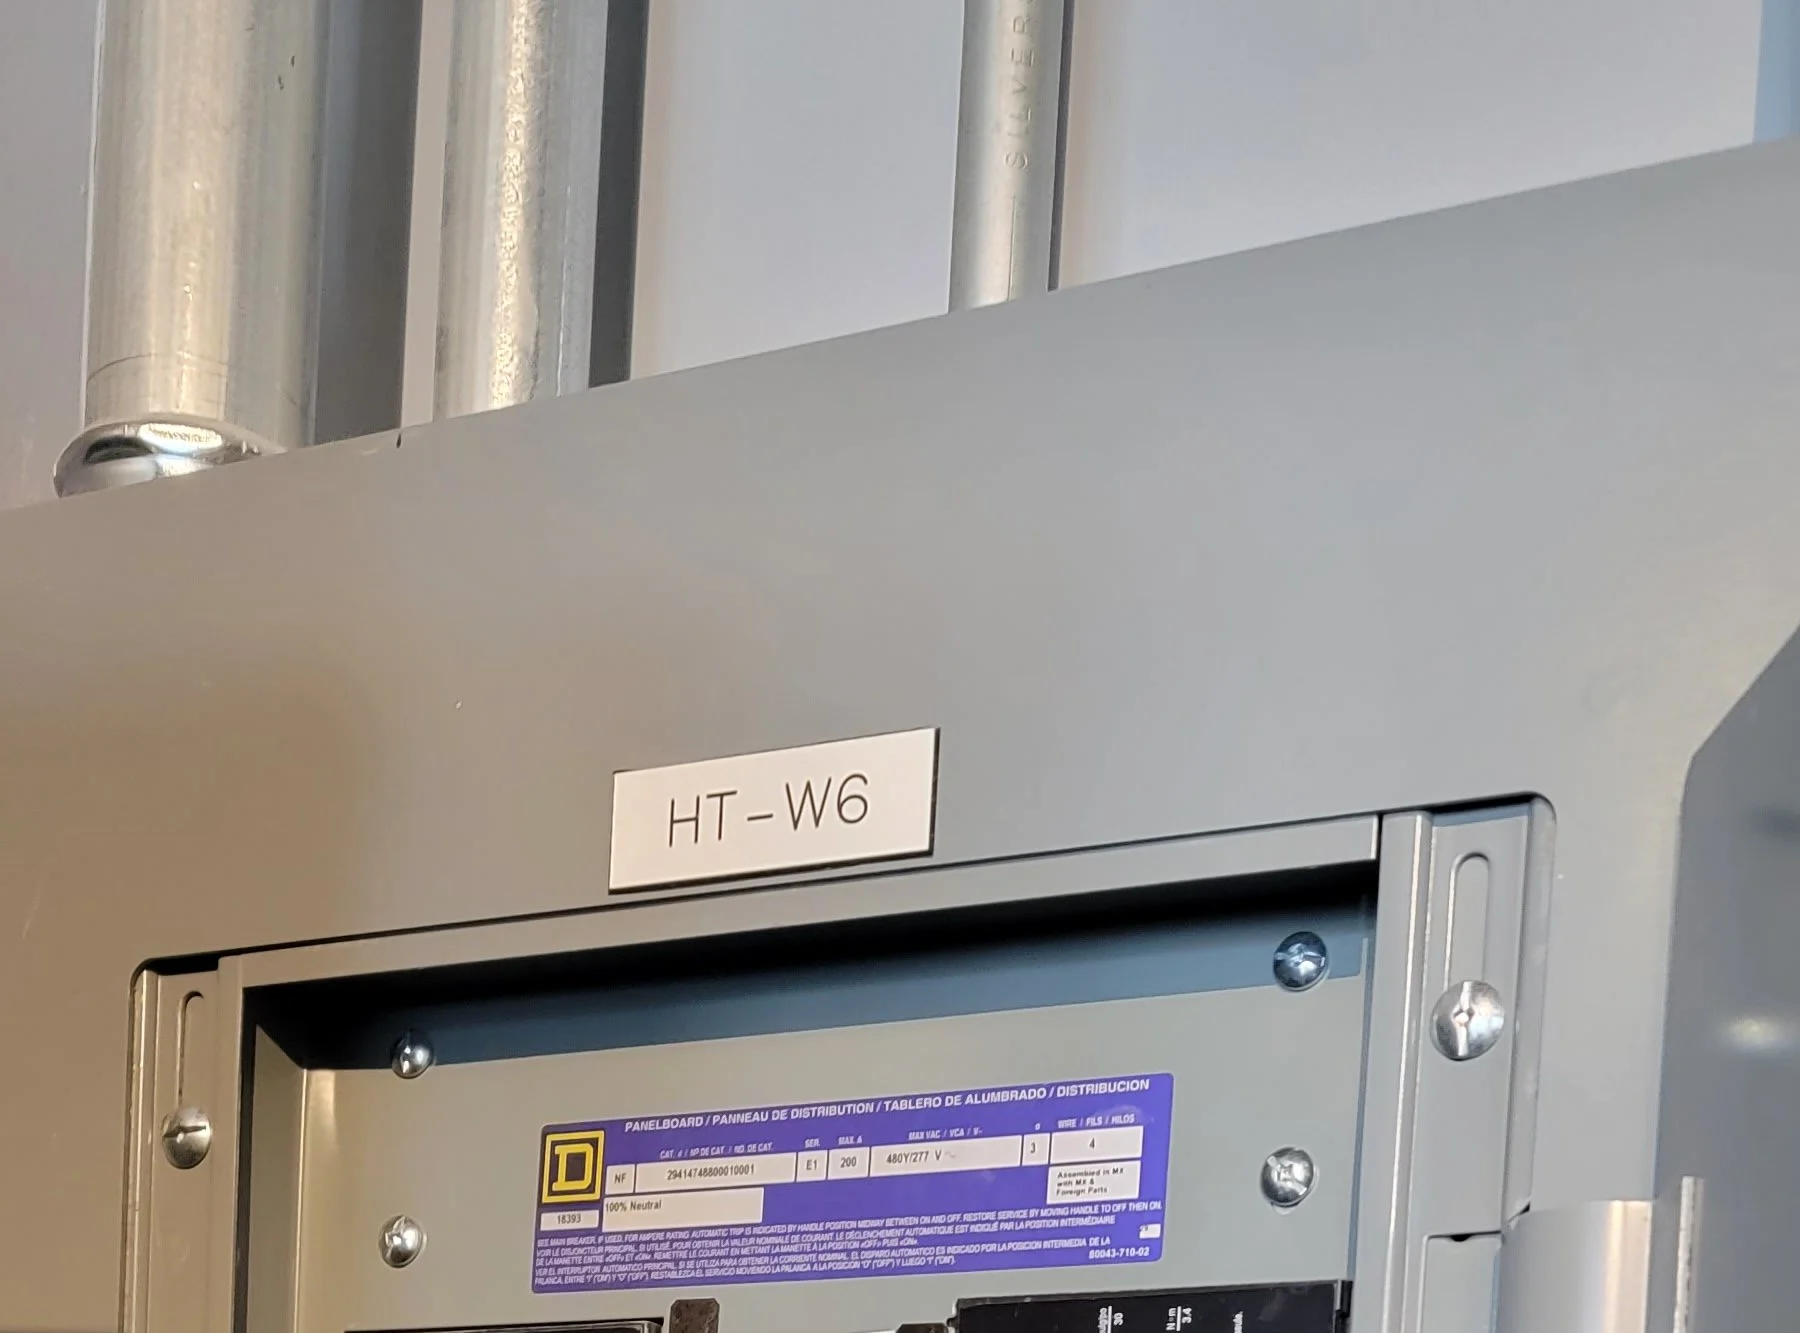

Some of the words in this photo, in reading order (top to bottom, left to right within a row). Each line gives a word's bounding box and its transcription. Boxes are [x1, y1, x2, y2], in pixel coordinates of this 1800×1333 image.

[1004, 0, 1040, 170] SILVER
[669, 774, 868, 847] HT-W6
[625, 1115, 703, 1133] PANELBOARD
[712, 1111, 768, 1126] PANNEAU
[771, 1109, 788, 1121] DE
[790, 1102, 874, 1120] DISTRIBUTION
[884, 1097, 942, 1111] TABLERO
[945, 1095, 962, 1107] DE
[964, 1088, 1047, 1105] ALUMBRADO
[1057, 1079, 1150, 1097] DISTRIBUCION
[614, 1172, 627, 1185] NF
[806, 1158, 818, 1171] E1
[840, 1156, 857, 1169] 200
[886, 1151, 929, 1165] 480Y/277
[1030, 1142, 1036, 1154] 3
[1089, 1137, 1096, 1150] 4
[556, 1213, 582, 1225] 18393
[605, 1200, 627, 1213] 100%
[630, 1199, 662, 1211] Neutral
